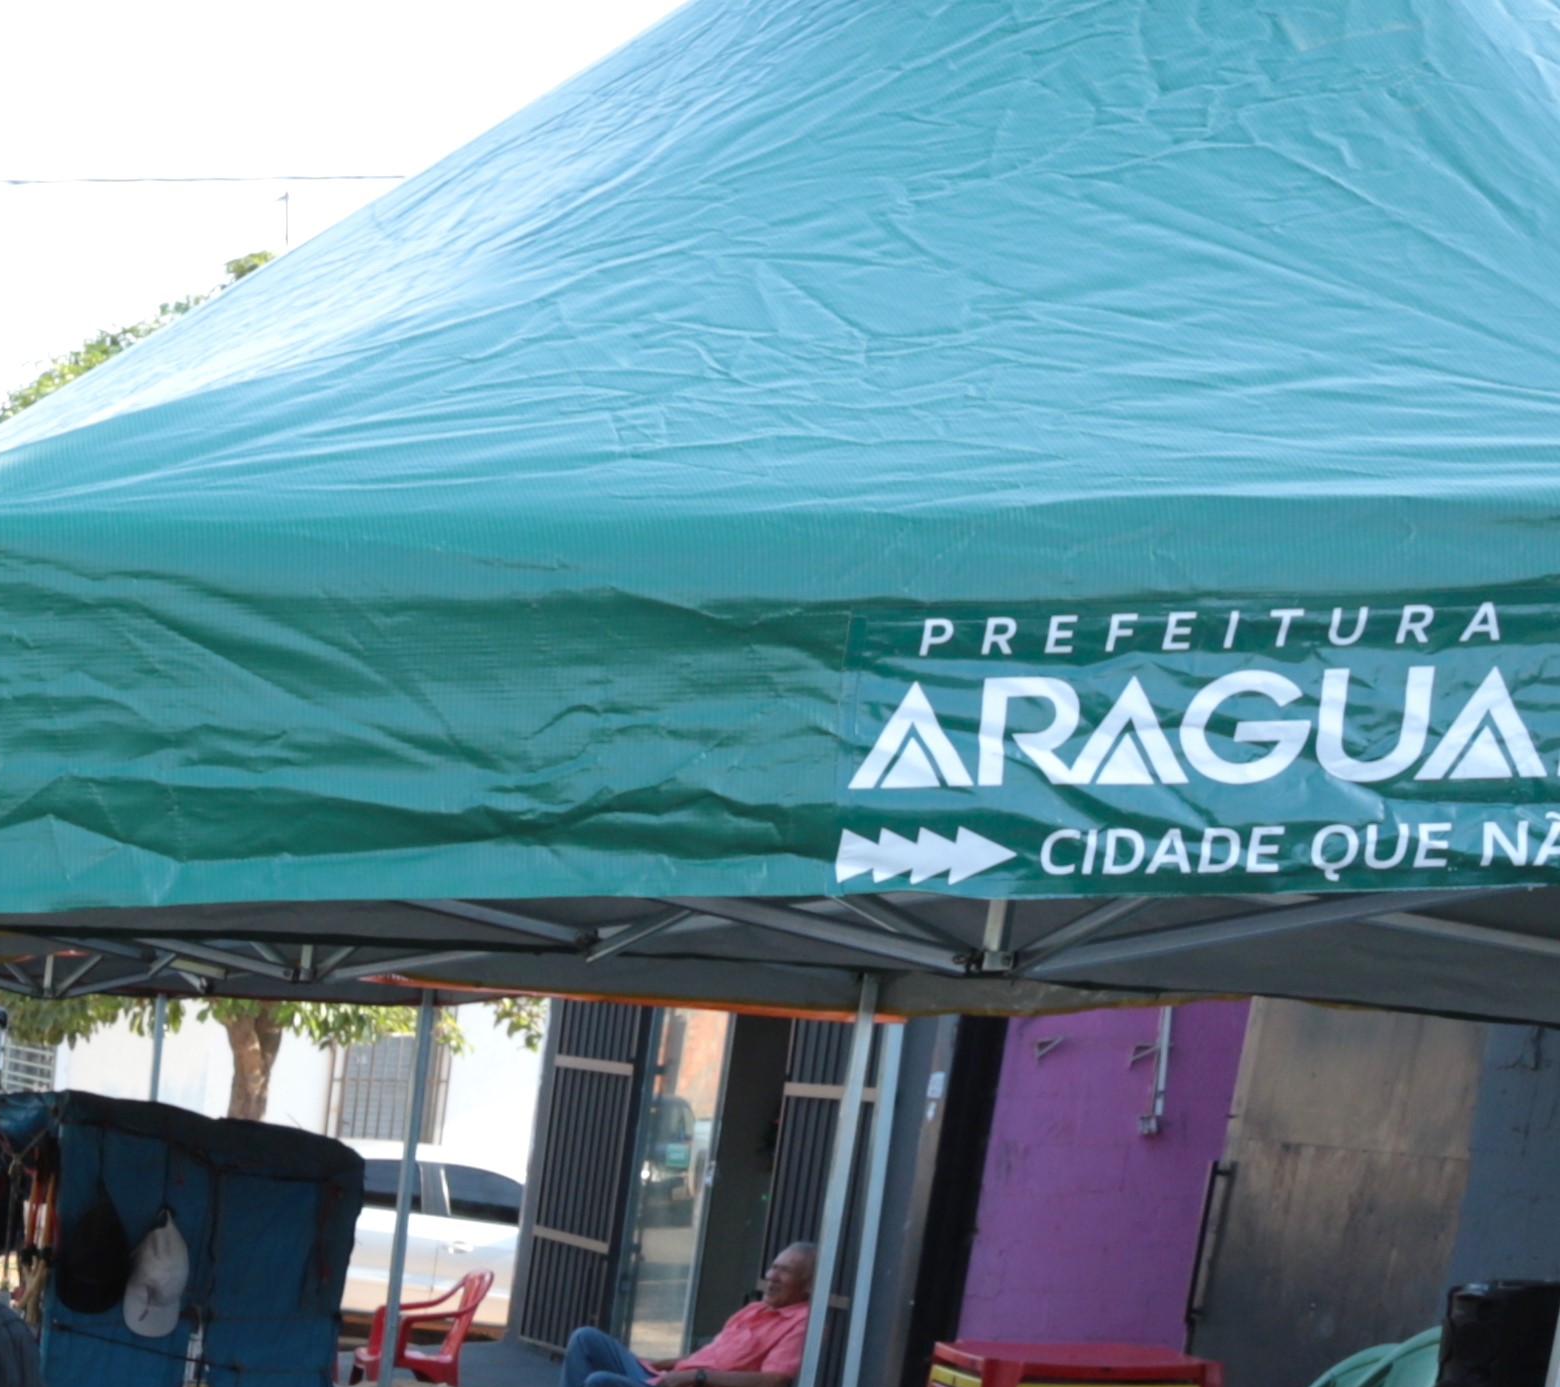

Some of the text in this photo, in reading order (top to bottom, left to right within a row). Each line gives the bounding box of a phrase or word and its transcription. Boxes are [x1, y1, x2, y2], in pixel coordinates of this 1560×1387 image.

[919, 601, 1502, 657] PREFEITURA
[847, 664, 1560, 790] ARAGUA
[1039, 825, 1286, 877] CIDADE
[1309, 822, 1452, 883] QUE
